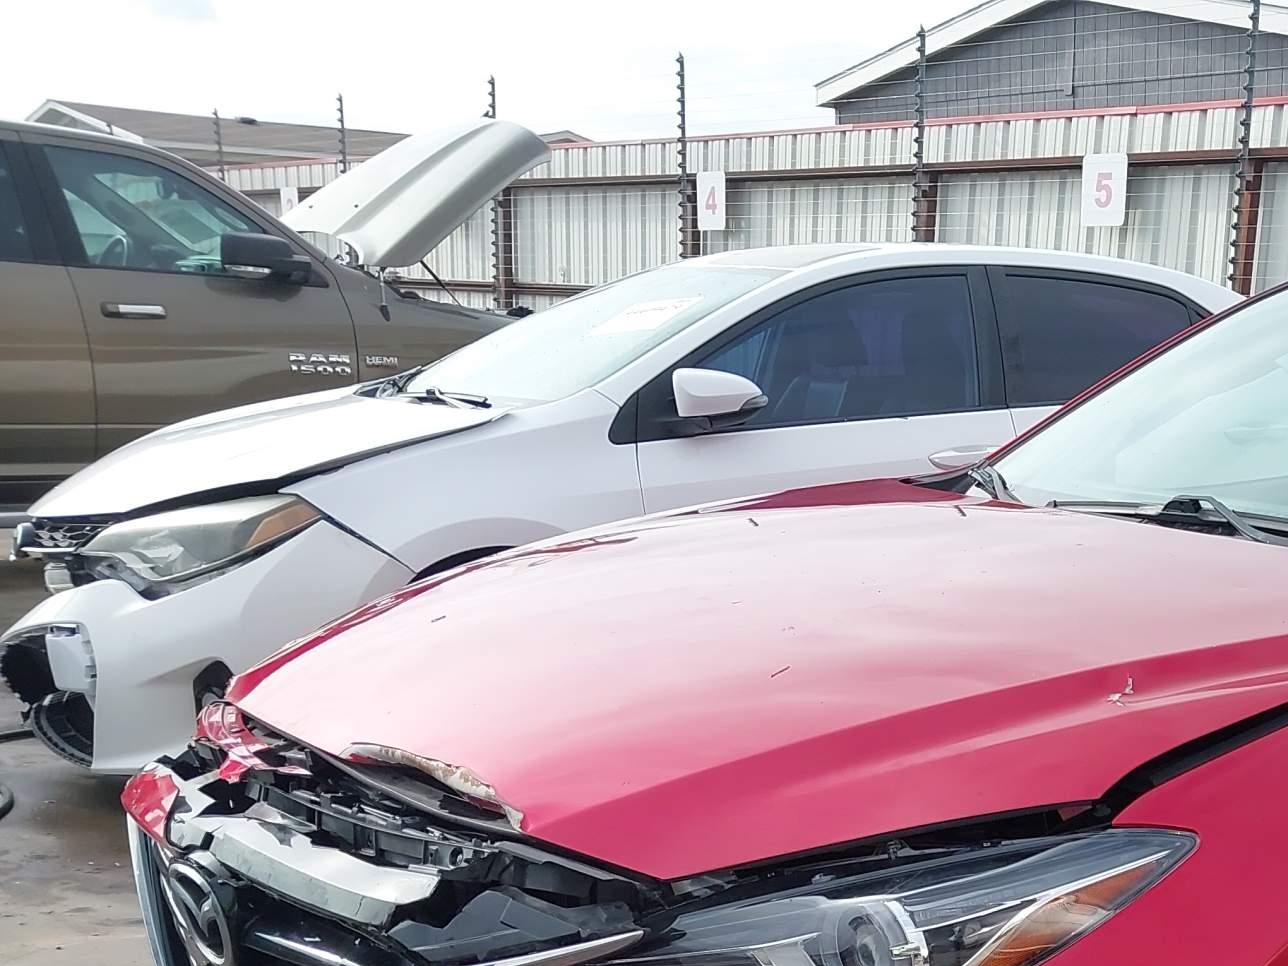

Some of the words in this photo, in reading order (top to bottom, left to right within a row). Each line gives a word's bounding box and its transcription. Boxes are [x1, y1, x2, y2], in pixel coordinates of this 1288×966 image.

[1095, 172, 1112, 208] 5
[705, 186, 717, 215] 4
[289, 352, 351, 364] RAM
[365, 355, 398, 367] HEMI
[289, 364, 352, 376] 1500
